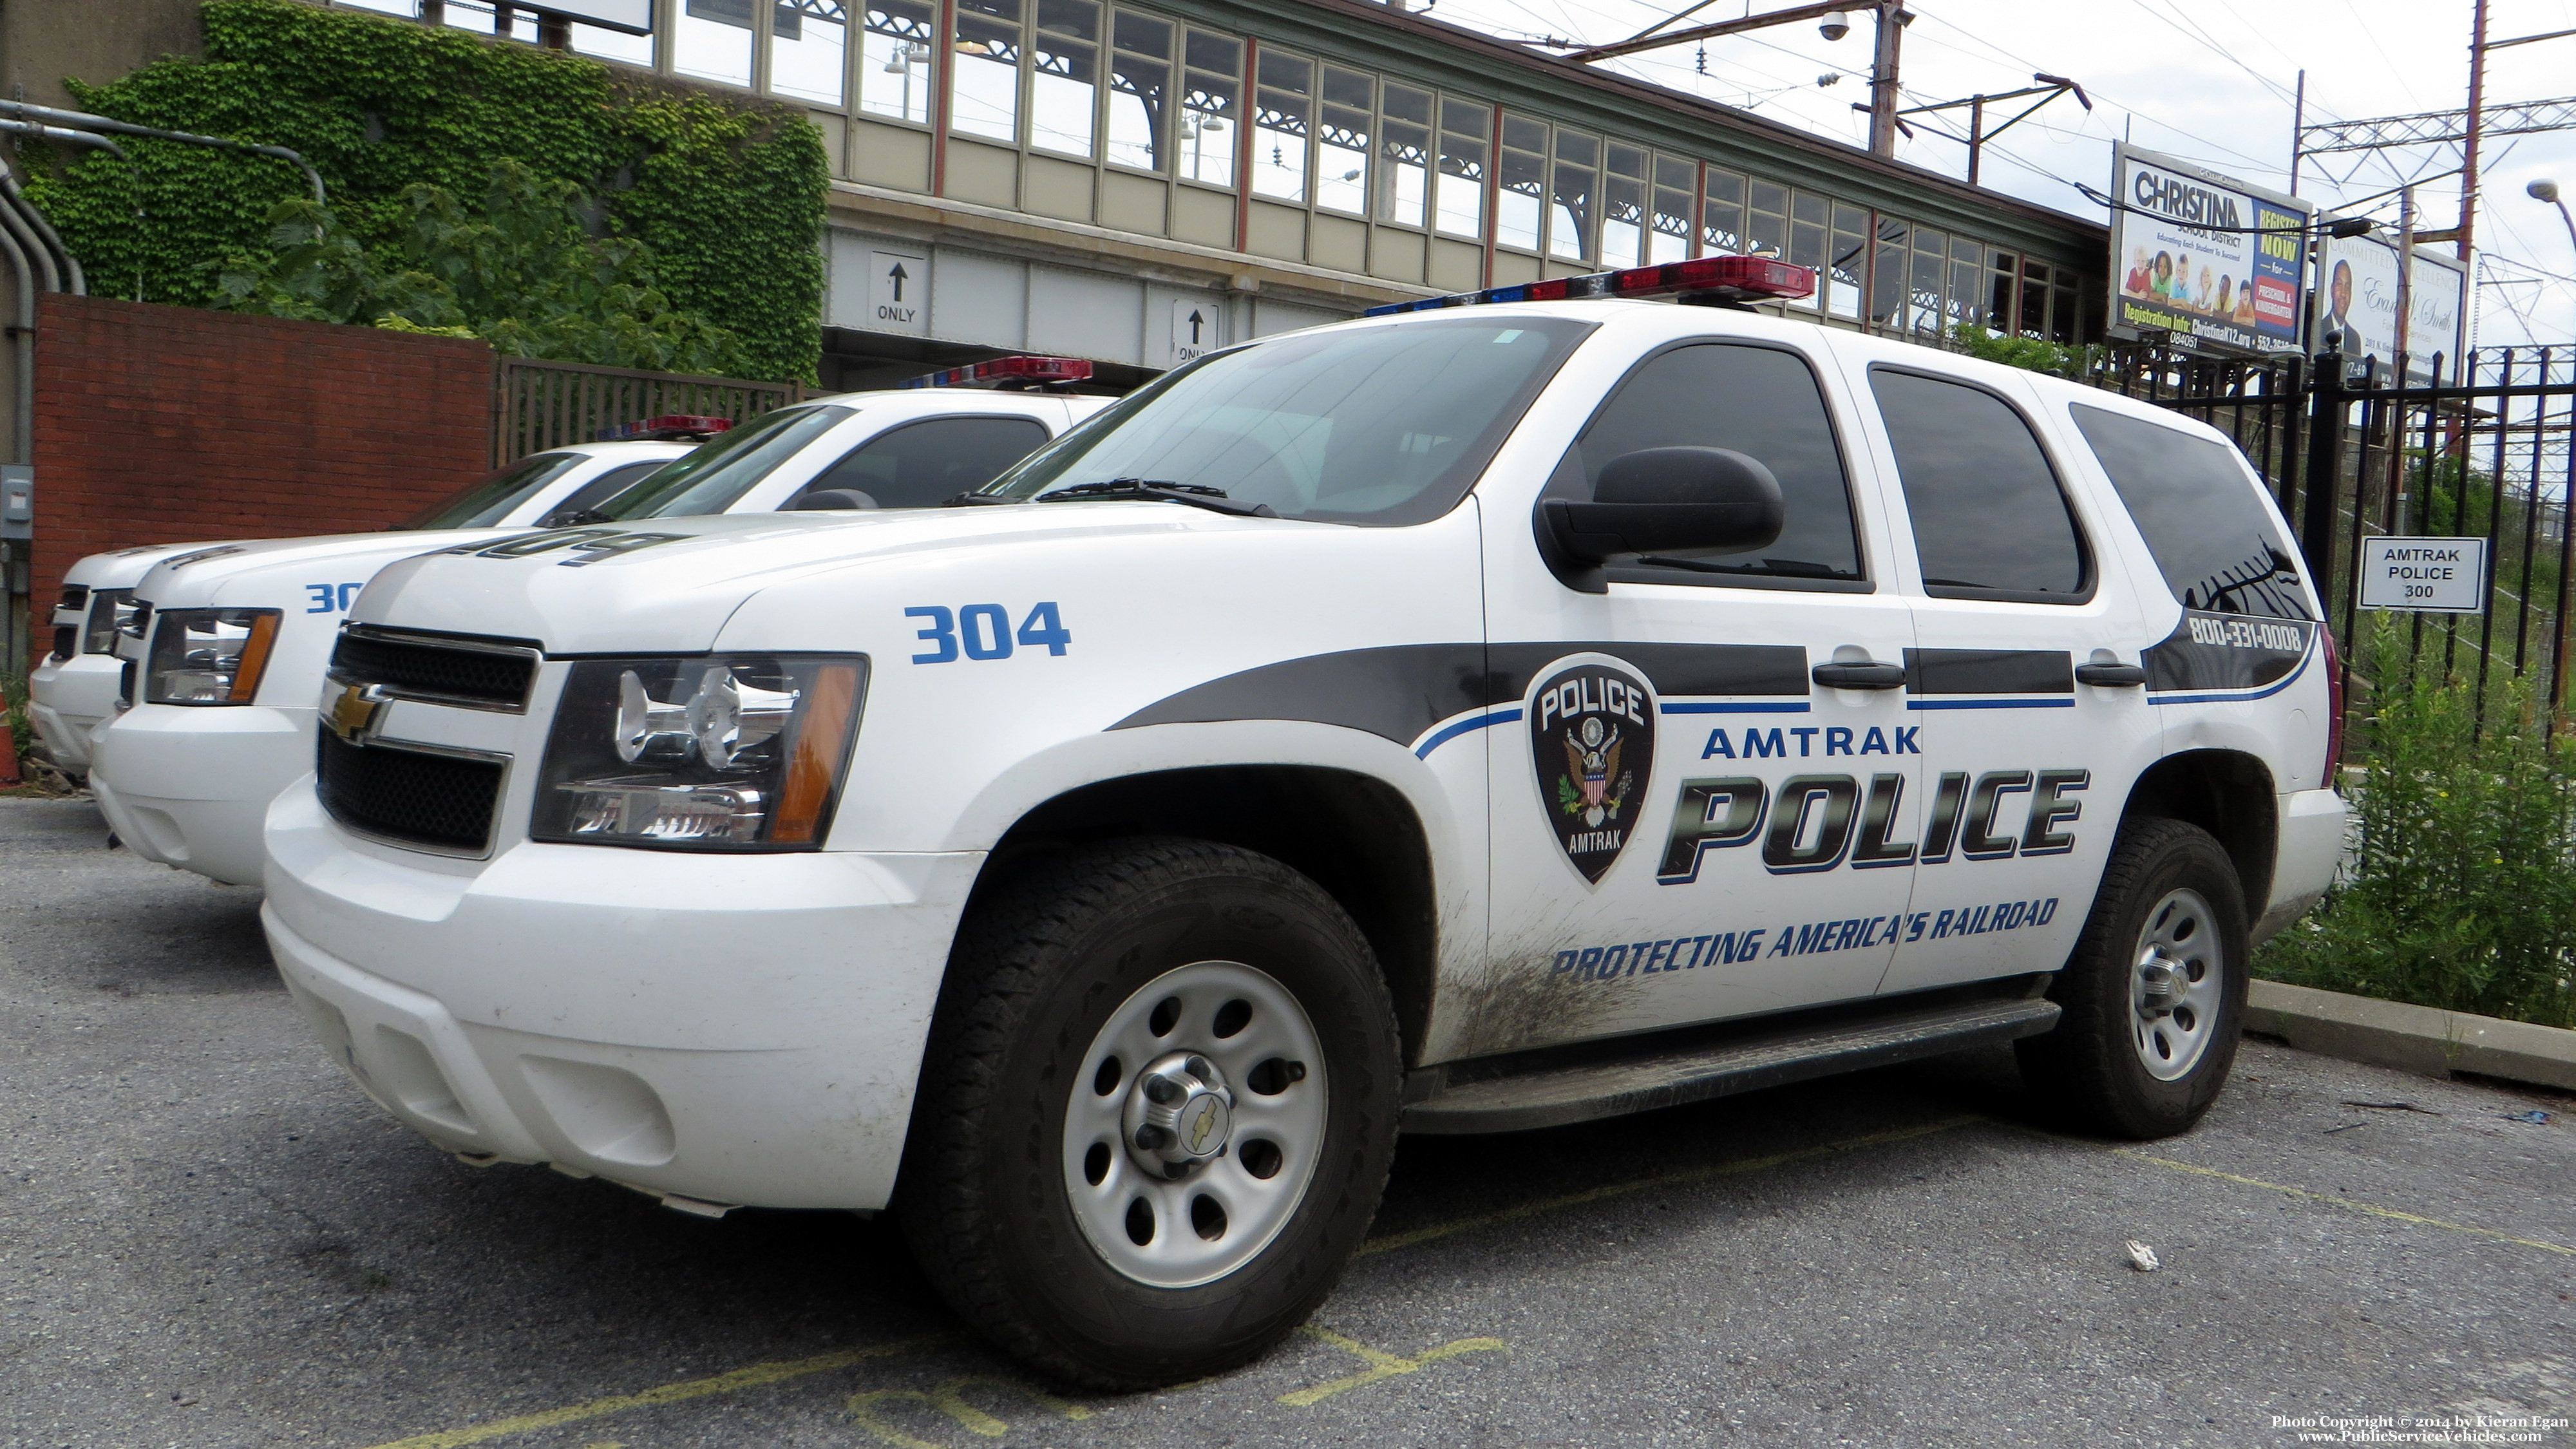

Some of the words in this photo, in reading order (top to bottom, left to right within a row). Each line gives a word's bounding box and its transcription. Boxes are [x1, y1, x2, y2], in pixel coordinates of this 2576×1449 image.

[2135, 171, 2241, 228] CHRISTINA
[2211, 230, 2241, 248] DISTRICT
[2259, 209, 2301, 240] REGISTER
[2260, 233, 2297, 261] NOW
[2330, 238, 2393, 270] COMMITTED
[2272, 261, 2283, 274] for
[878, 305, 916, 323] ONLY
[2124, 302, 2172, 329] Registration
[2174, 314, 2190, 333] Info:
[2192, 318, 2251, 348] ChristinaK12.org
[2170, 331, 2199, 349] 084051
[2384, 549, 2461, 562] AMTRAK
[2389, 567, 2454, 580] POLICE
[2405, 585, 2434, 598] 300
[904, 601, 1072, 665] 304
[2188, 617, 2302, 652] 800-331-0008
[1541, 677, 1645, 732] POLICE
[1701, 725, 1922, 760] AMTRAK
[1569, 829, 1622, 854] AMTRAK
[1655, 768, 2092, 886] POLICE
[1546, 928, 1767, 981] PROTECTING
[1766, 911, 1931, 958] AMERICA'S
[1931, 897, 2059, 938] RAILROAD
